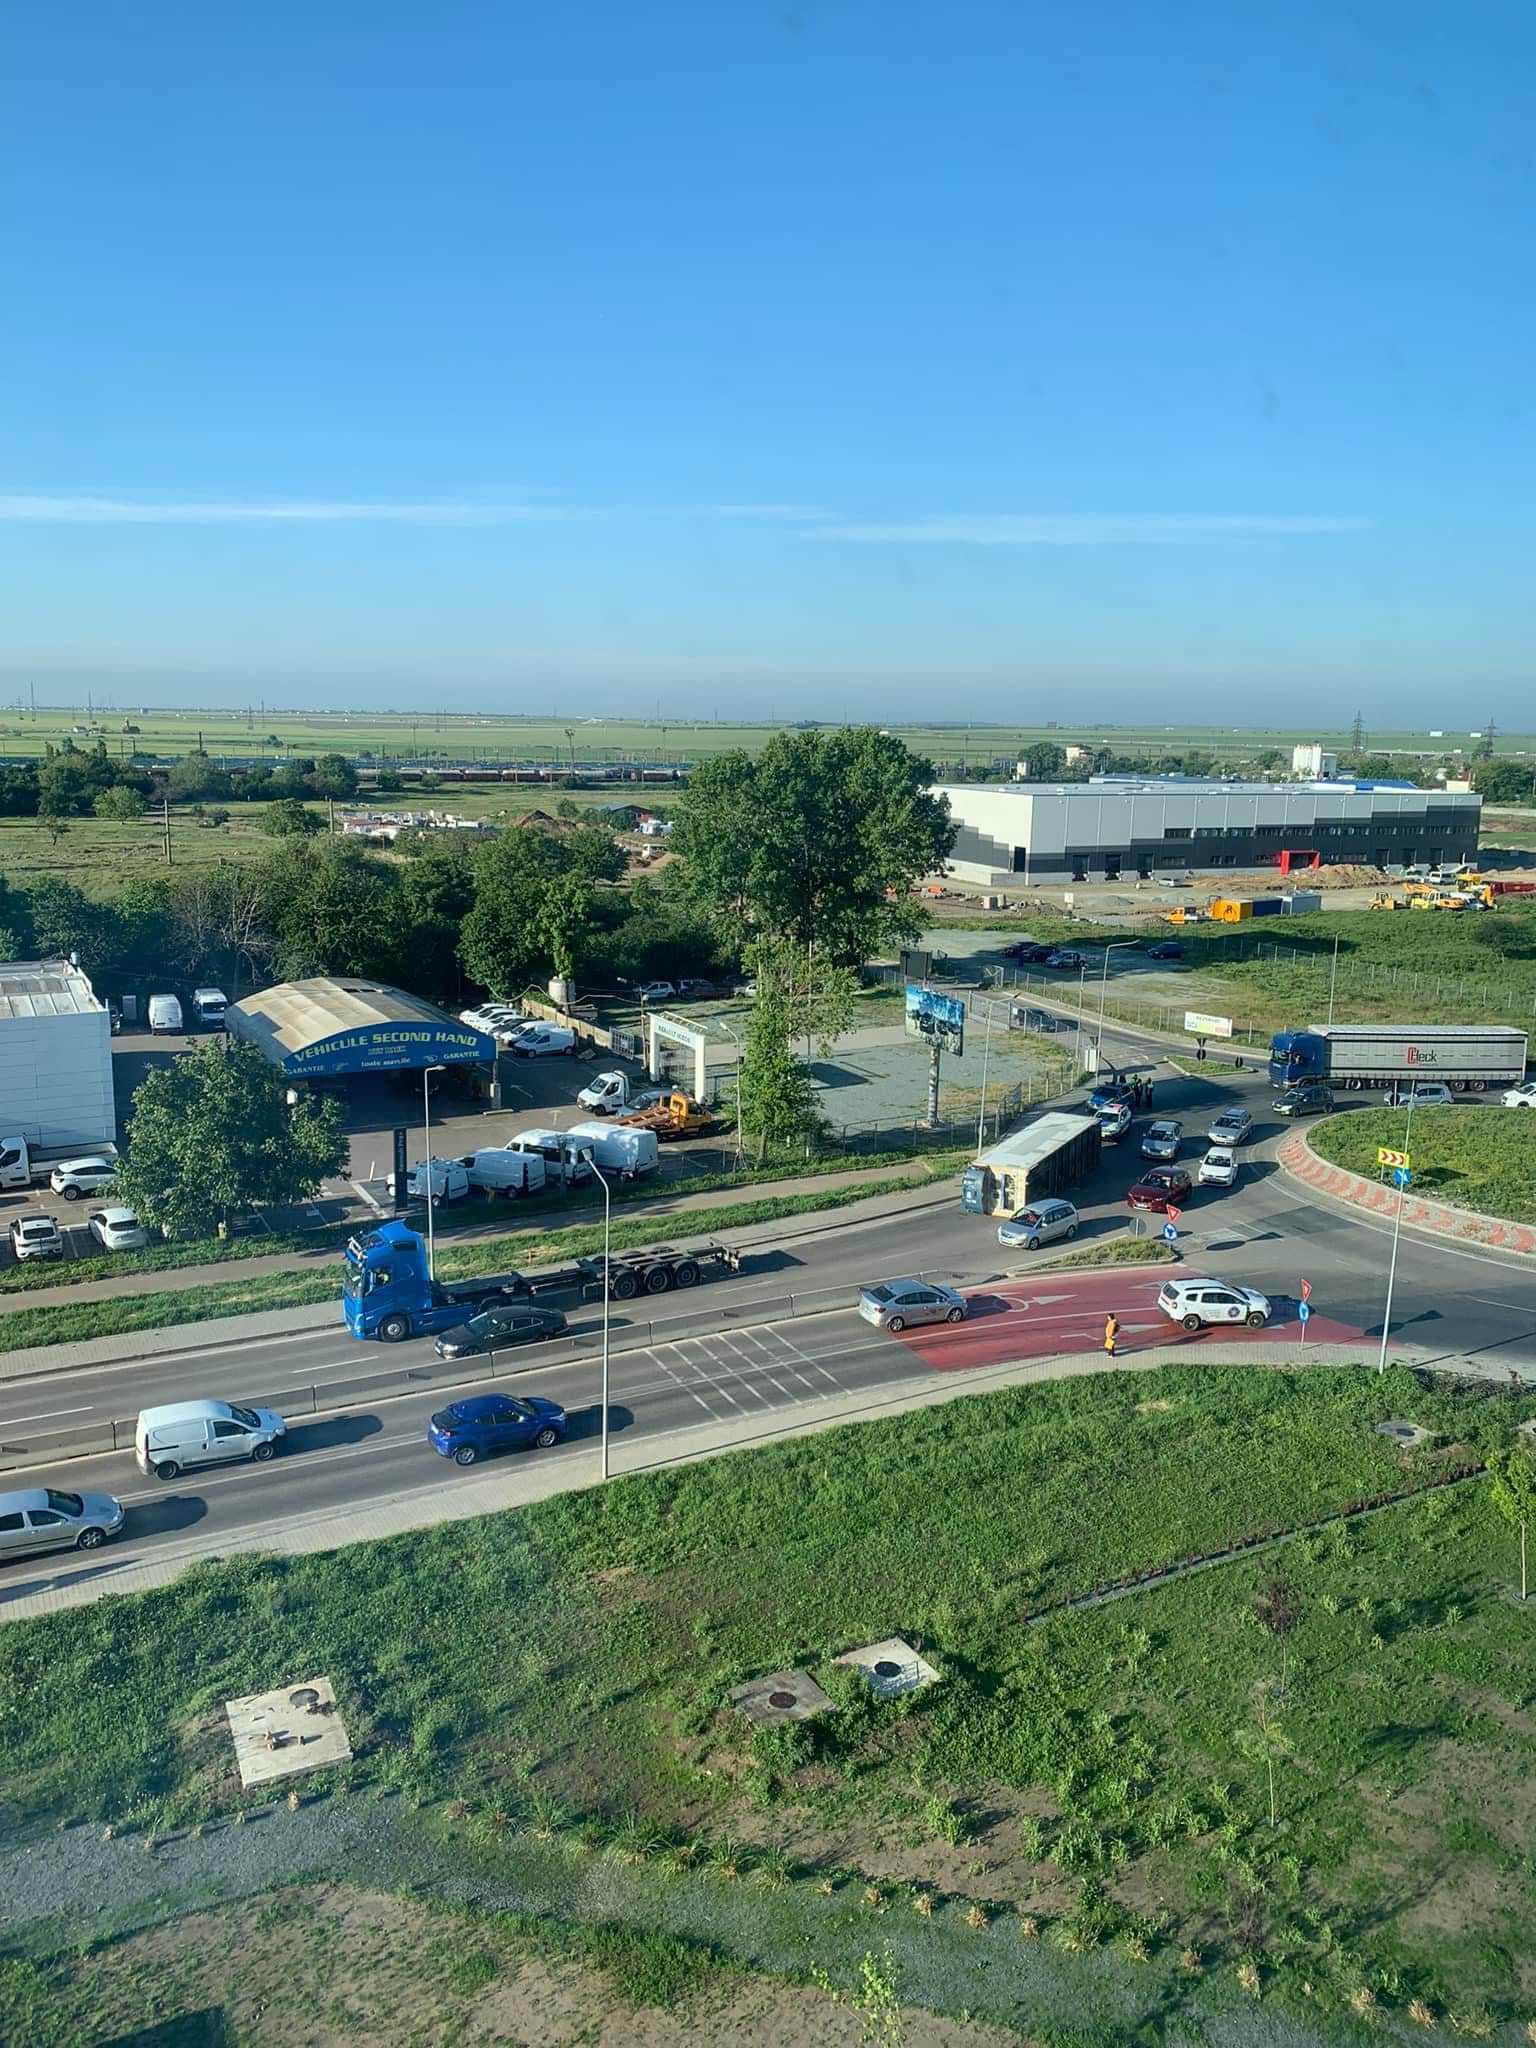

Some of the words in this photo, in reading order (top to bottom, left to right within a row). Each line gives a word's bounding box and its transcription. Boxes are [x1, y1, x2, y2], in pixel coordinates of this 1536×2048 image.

[294, 1035, 368, 1062] VEHICULE
[372, 1031, 431, 1044] SECOND
[435, 1031, 478, 1047] HAND
[443, 1050, 480, 1060] GARANTIE
